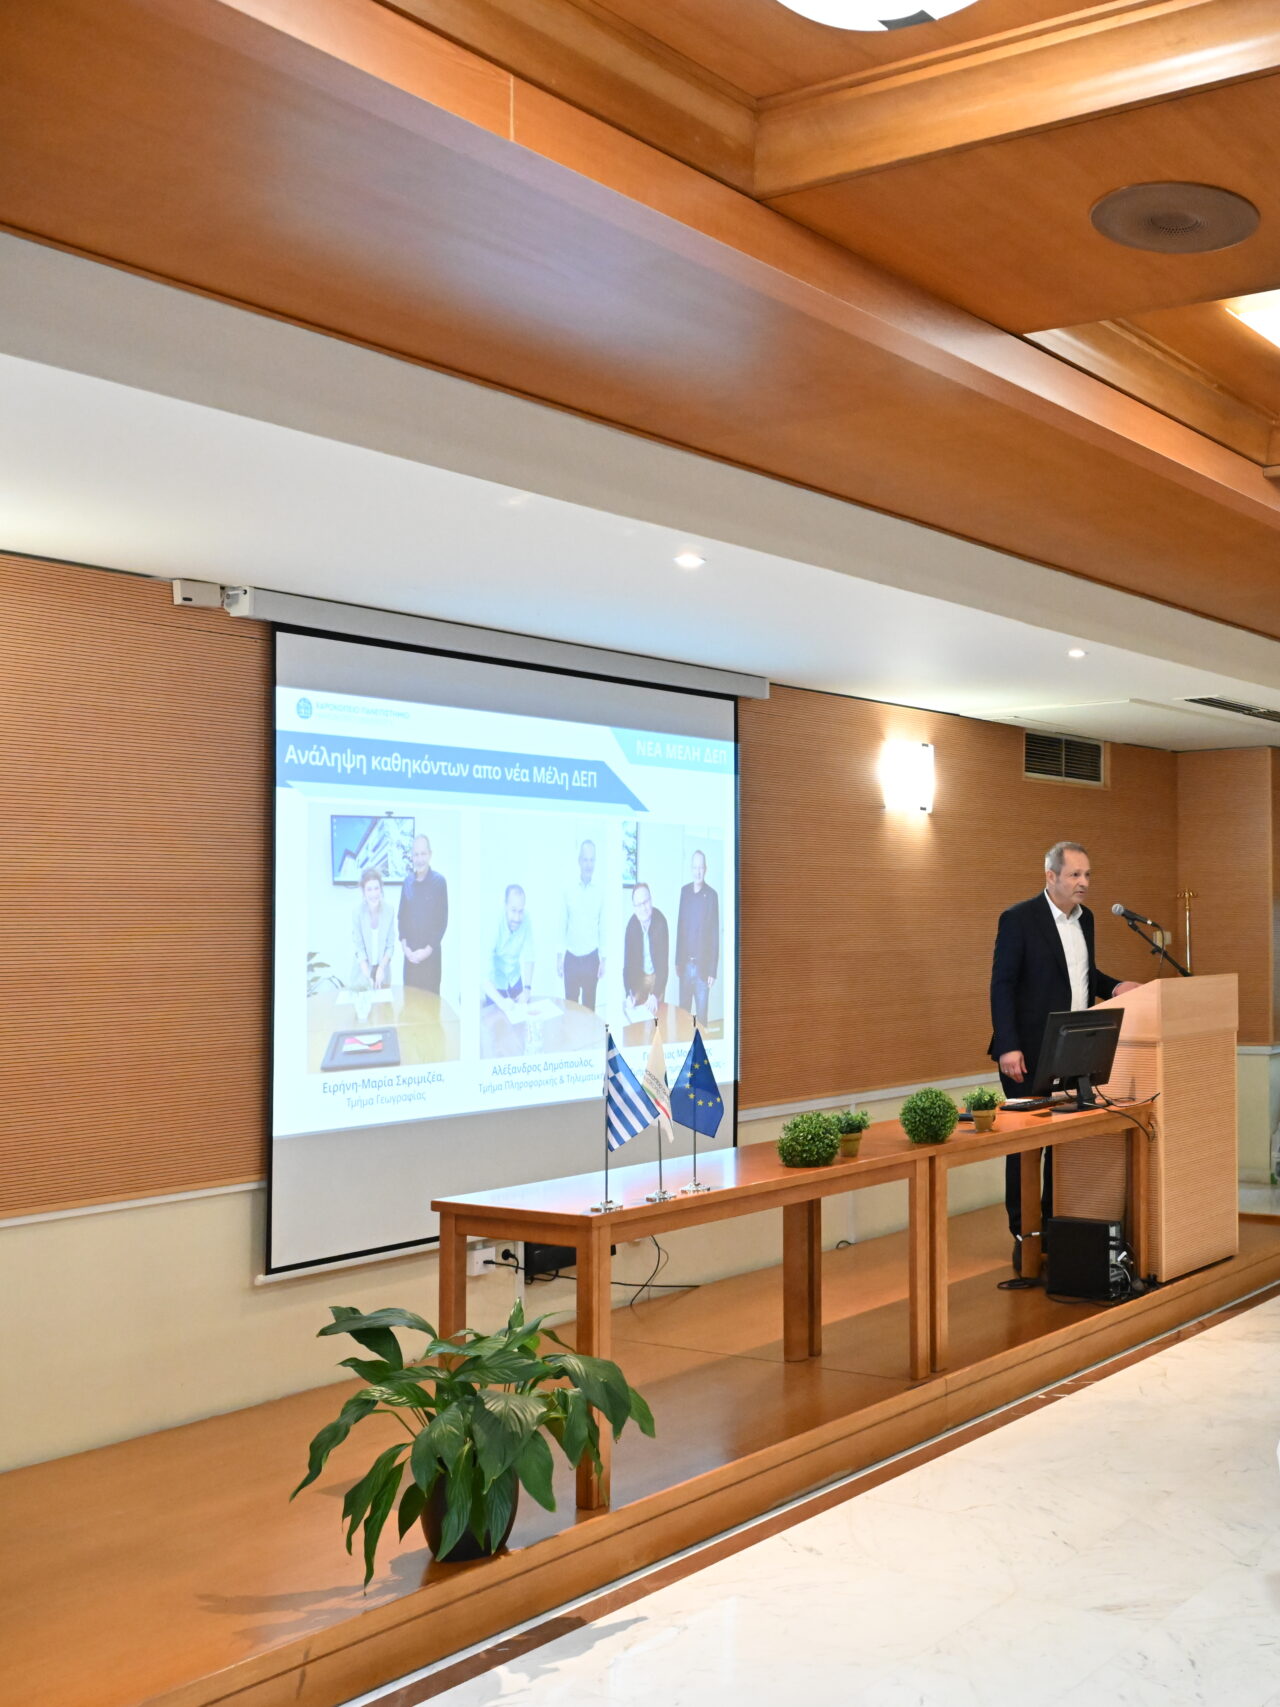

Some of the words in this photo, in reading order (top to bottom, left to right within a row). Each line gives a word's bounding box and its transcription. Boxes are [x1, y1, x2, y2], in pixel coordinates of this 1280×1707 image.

[636, 739, 662, 757] ΝΕΑ
[665, 743, 701, 762] ΜΕΛΗ
[703, 747, 727, 764] ΔΕΠ
[285, 744, 367, 775] Ανάληψη
[371, 752, 469, 779] καθηκόντων
[472, 764, 502, 780] απο
[504, 763, 530, 782] νέα
[533, 765, 569, 791] Μέλη
[571, 769, 597, 788] ΔΕΠ
[491, 1062, 541, 1077] Αλέξανδρος
[322, 1075, 393, 1096] Ειρήνη-Μαρία
[346, 1096, 375, 1110] Τμήμα
